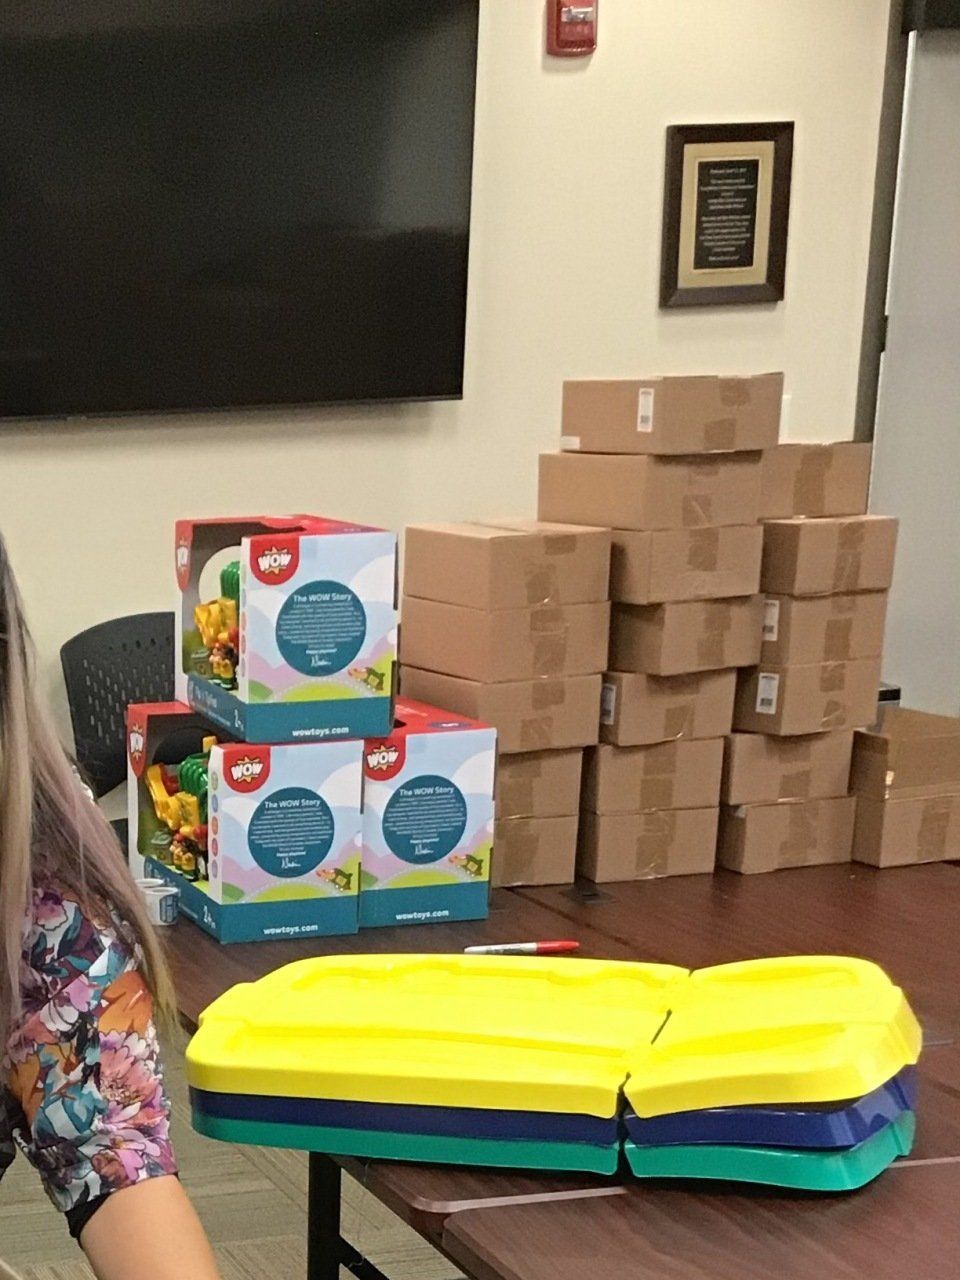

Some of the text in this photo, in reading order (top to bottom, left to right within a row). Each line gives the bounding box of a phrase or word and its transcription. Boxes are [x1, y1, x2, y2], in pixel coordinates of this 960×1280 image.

[257, 553, 292, 571] WOW
[293, 592, 352, 603] The WOW Story
[292, 726, 350, 737] wowtoys.com
[366, 751, 399, 768] WOW
[230, 762, 264, 780] WOW
[399, 785, 455, 796] The WOW Story
[264, 798, 321, 808] The WOW Story
[395, 910, 449, 920] wowtoys.com
[263, 924, 319, 935] wowtoys.com
